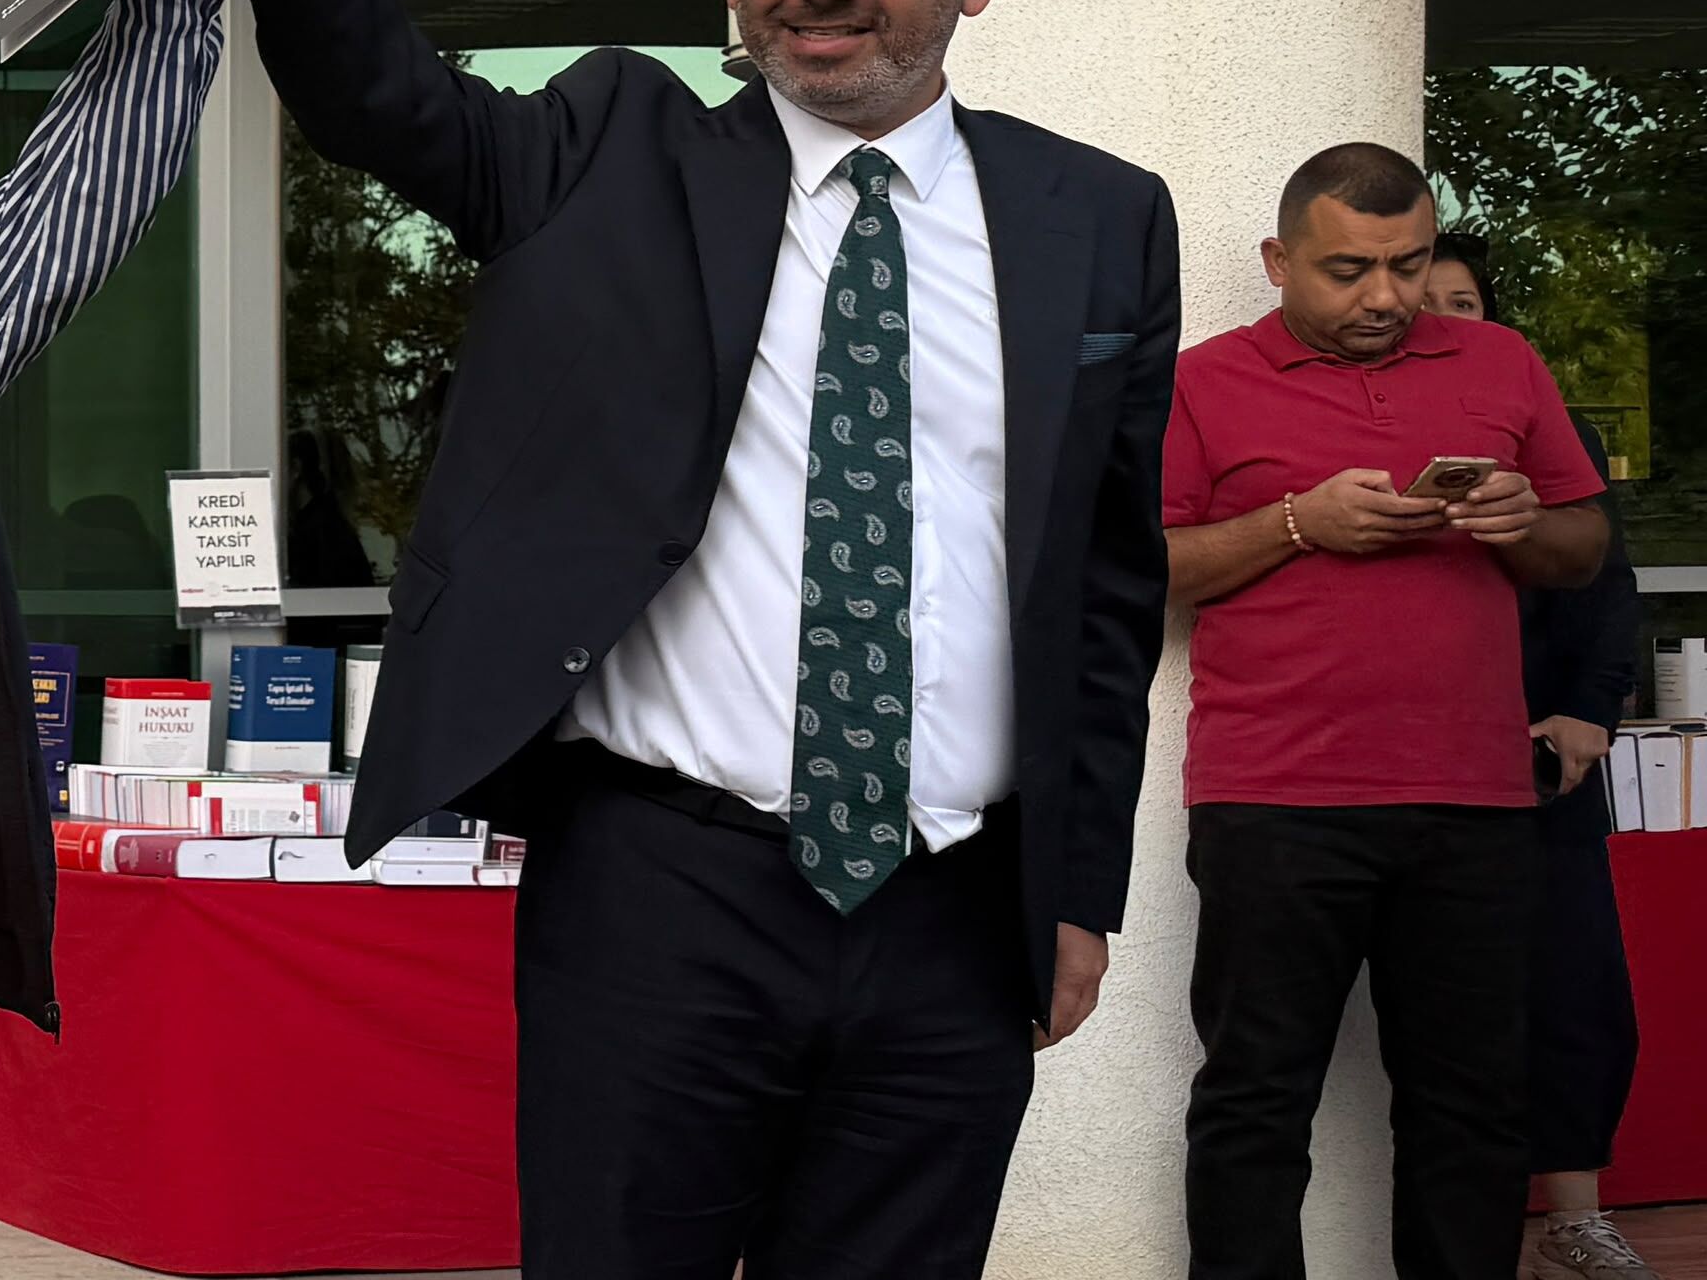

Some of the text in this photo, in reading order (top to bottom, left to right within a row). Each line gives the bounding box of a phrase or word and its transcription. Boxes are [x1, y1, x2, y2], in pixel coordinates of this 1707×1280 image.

[198, 491, 245, 508] KREDİ
[188, 515, 258, 529] KARTINA
[196, 531, 252, 548] TAKSİT
[195, 555, 256, 568] YAPILIR
[144, 705, 190, 720] İNŞAAT
[138, 722, 195, 734] HUKUKU
